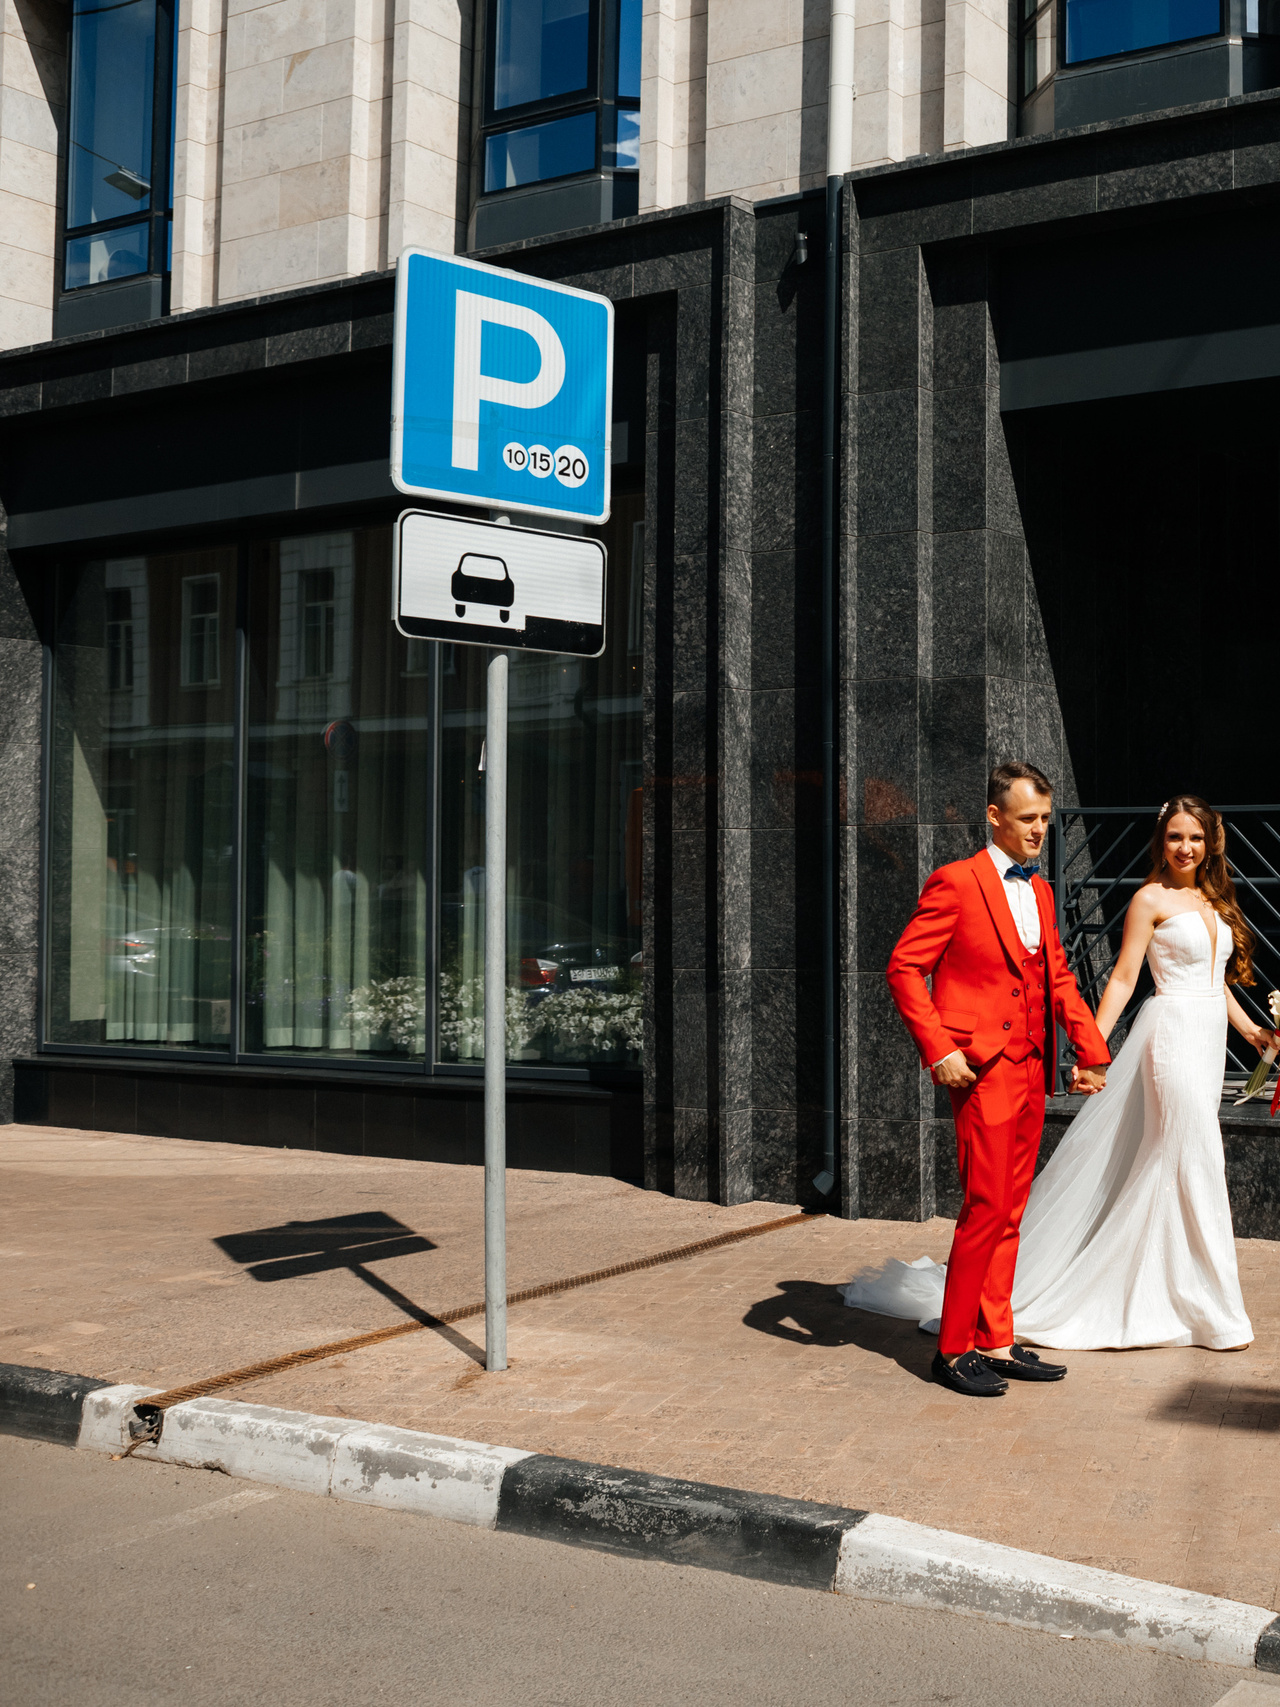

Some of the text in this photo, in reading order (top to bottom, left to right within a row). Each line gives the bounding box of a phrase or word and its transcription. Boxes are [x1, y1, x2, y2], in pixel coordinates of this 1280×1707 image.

[451, 289, 566, 471] P
[506, 448, 587, 480] 10 15 20
